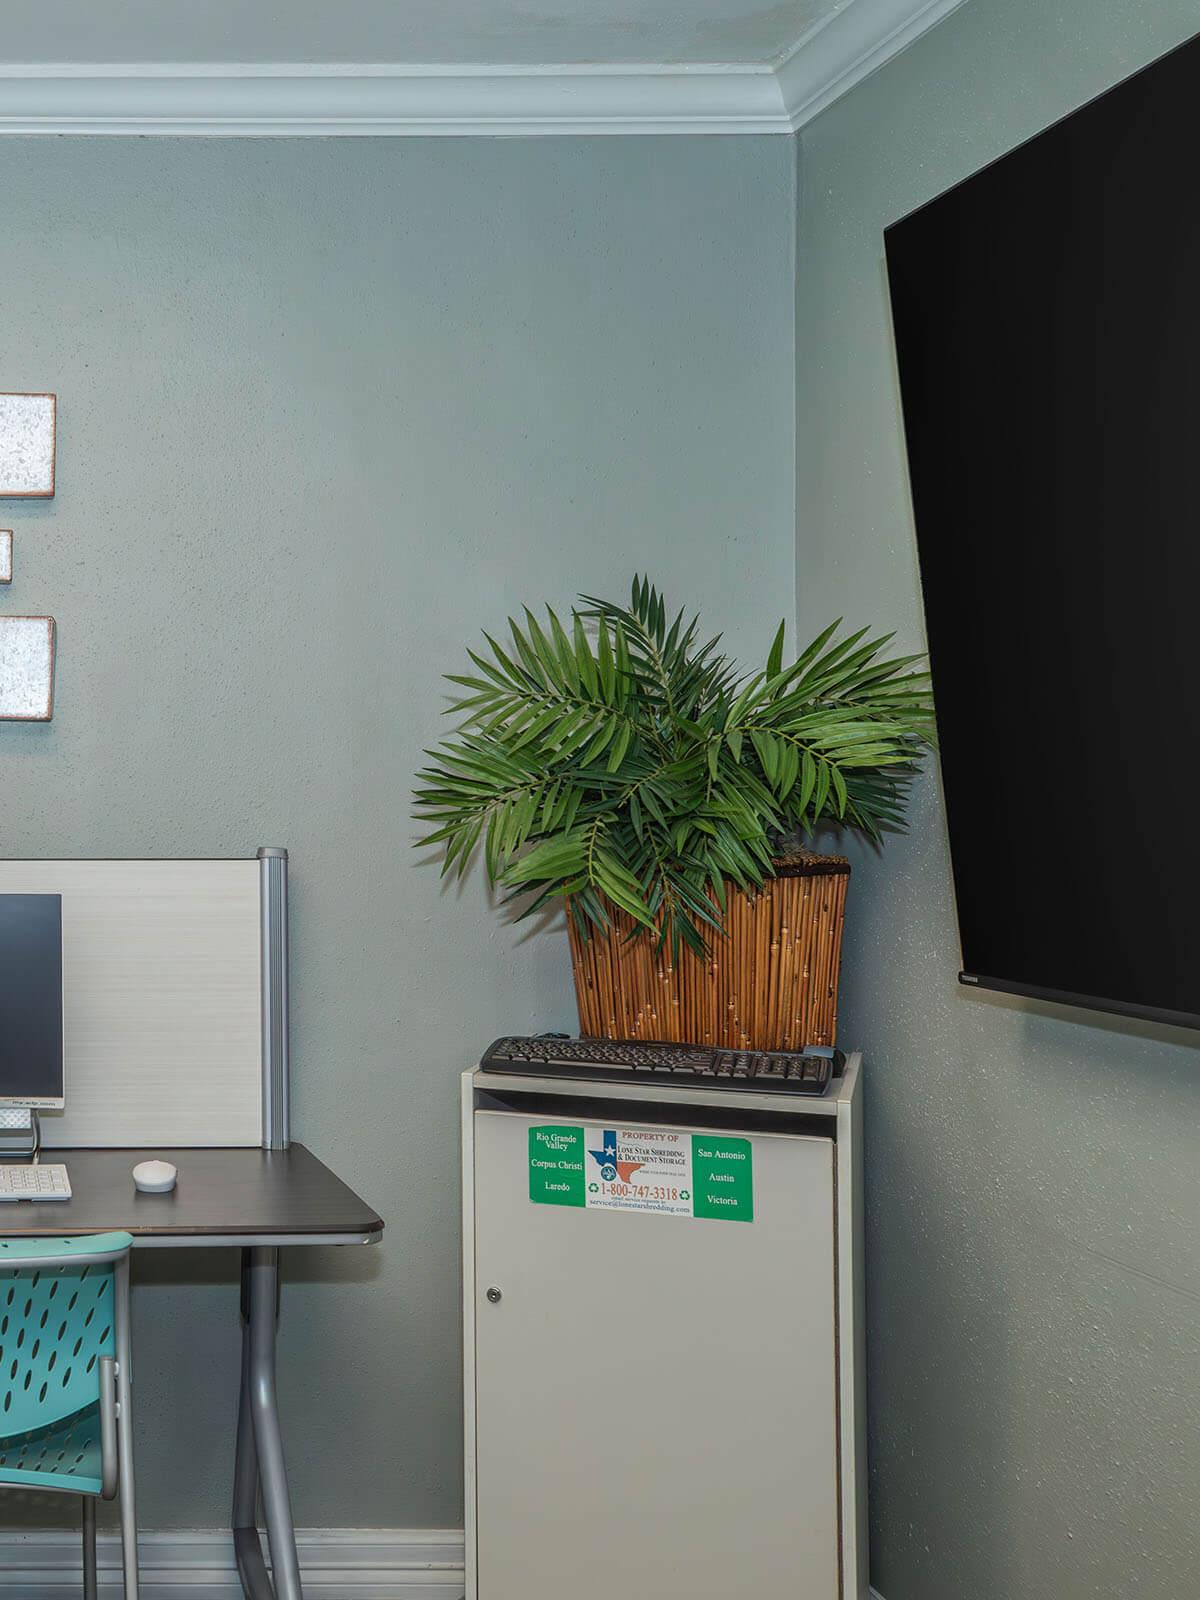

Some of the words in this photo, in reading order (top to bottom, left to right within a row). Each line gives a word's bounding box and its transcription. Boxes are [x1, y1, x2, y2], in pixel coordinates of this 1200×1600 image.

[536, 1132, 549, 1141] Rio
[551, 1134, 577, 1143] Grande
[622, 1131, 666, 1141] PROPERTY
[546, 1141, 569, 1152] Valley
[634, 1147, 650, 1155] STAR
[650, 1148, 686, 1157] SHREDDING
[625, 1154, 658, 1163] DOCUMENT
[659, 1156, 686, 1165] STORAGE
[697, 1148, 713, 1158] San
[714, 1150, 746, 1160] Antonio
[531, 1159, 557, 1169] Corpus
[558, 1160, 583, 1170] Christi
[709, 1173, 735, 1183] Austin
[545, 1181, 570, 1191] Laredo
[601, 1182, 678, 1200] 1-800-747-3318
[707, 1195, 738, 1206] Victoria
